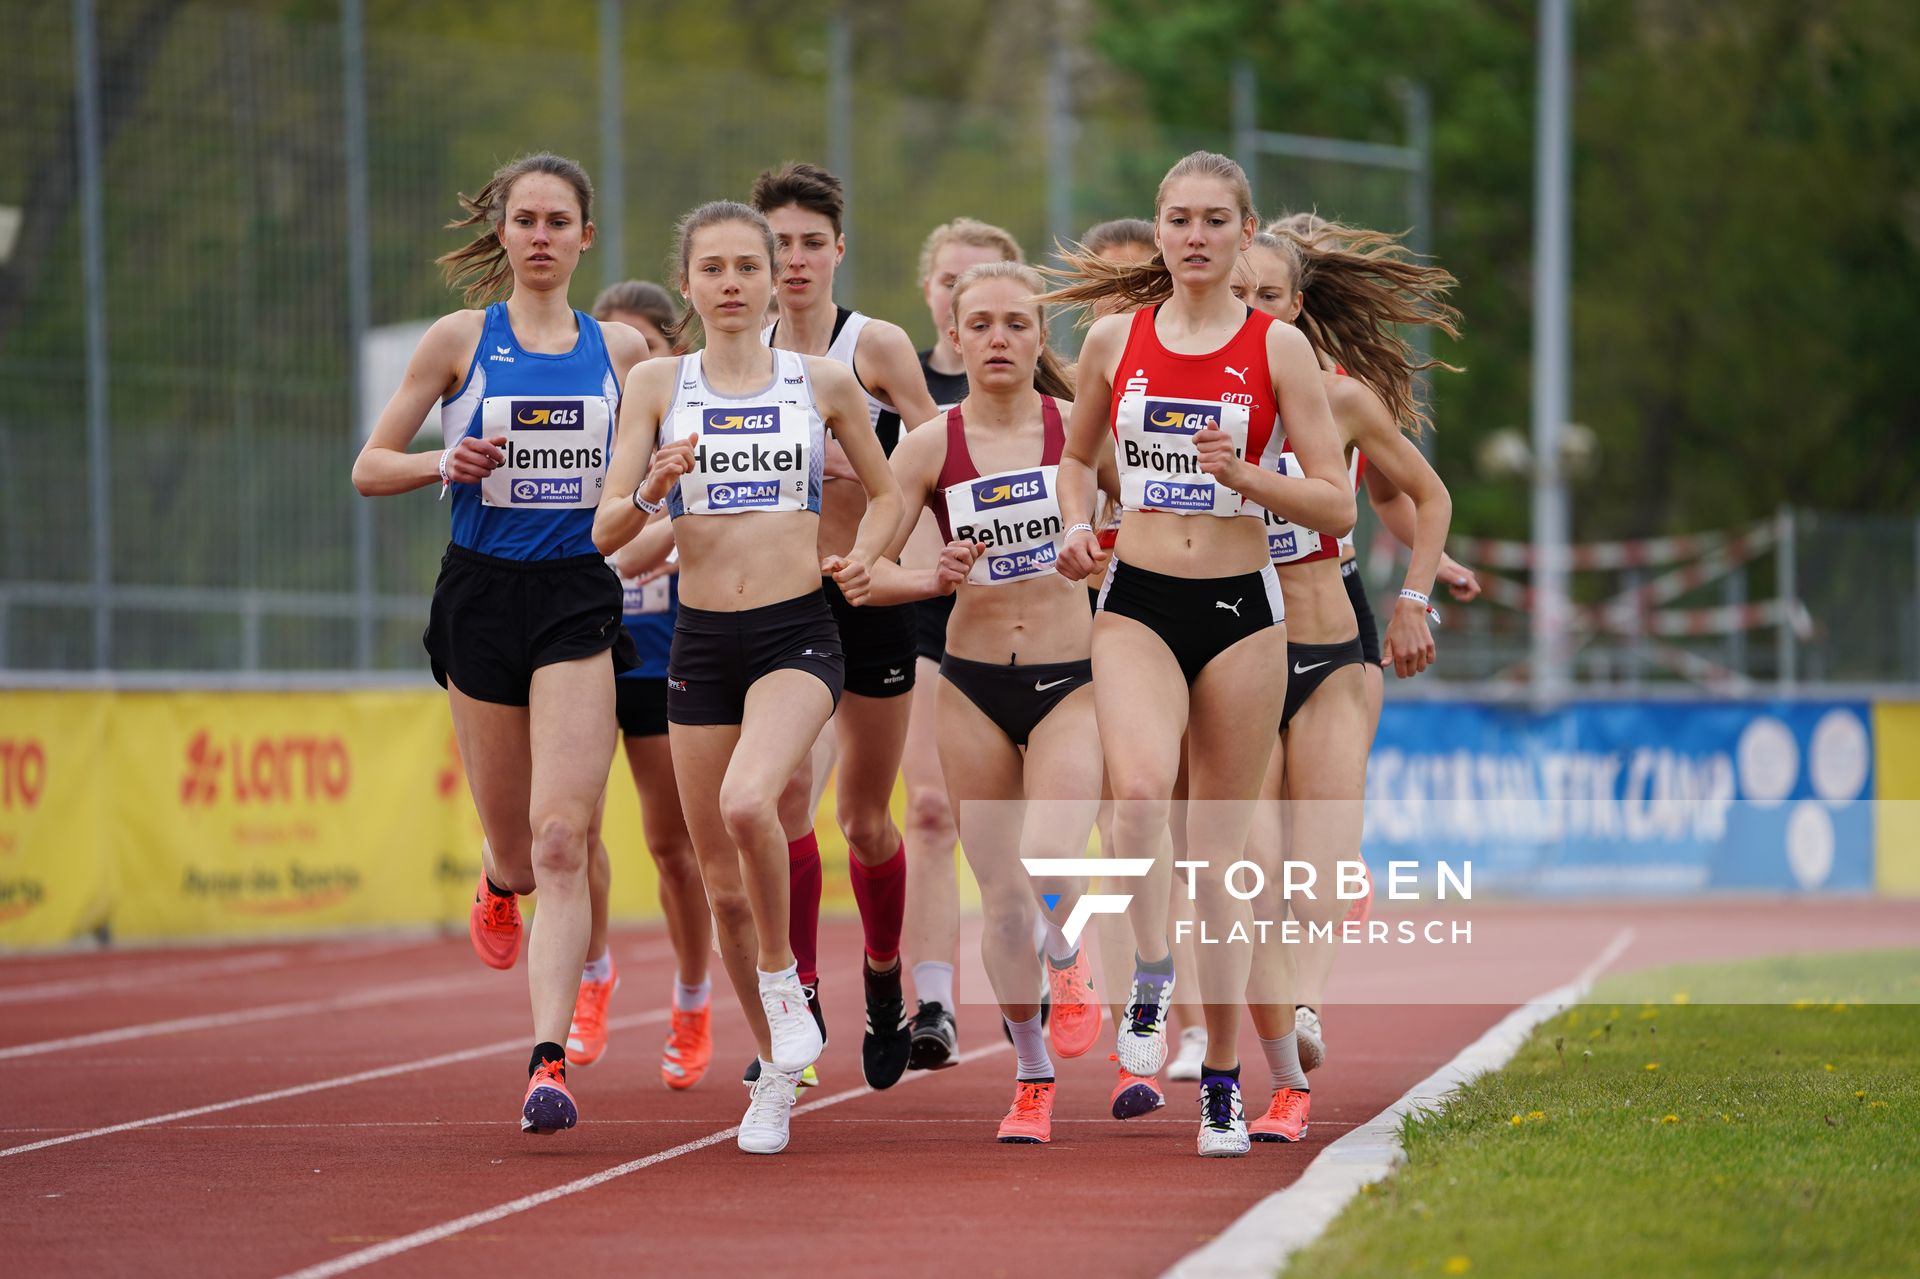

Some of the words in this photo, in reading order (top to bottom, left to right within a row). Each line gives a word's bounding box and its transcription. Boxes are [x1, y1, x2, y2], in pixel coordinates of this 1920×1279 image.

[1221, 392, 1253, 405] GfTD
[549, 409, 578, 425] GLS
[743, 414, 774, 430] GLS
[1184, 413, 1214, 430] GLS
[1124, 440, 1241, 474] Bröm
[541, 482, 579, 494] PLAN
[737, 485, 777, 498] PLAN
[1011, 480, 1040, 498] GLS
[1171, 488, 1212, 501] PLAN
[956, 515, 1065, 549] Behren
[1270, 536, 1294, 549] AN
[1016, 547, 1054, 568] PLAN
[623, 590, 641, 602] AN
[231, 737, 350, 802] LOTTO
